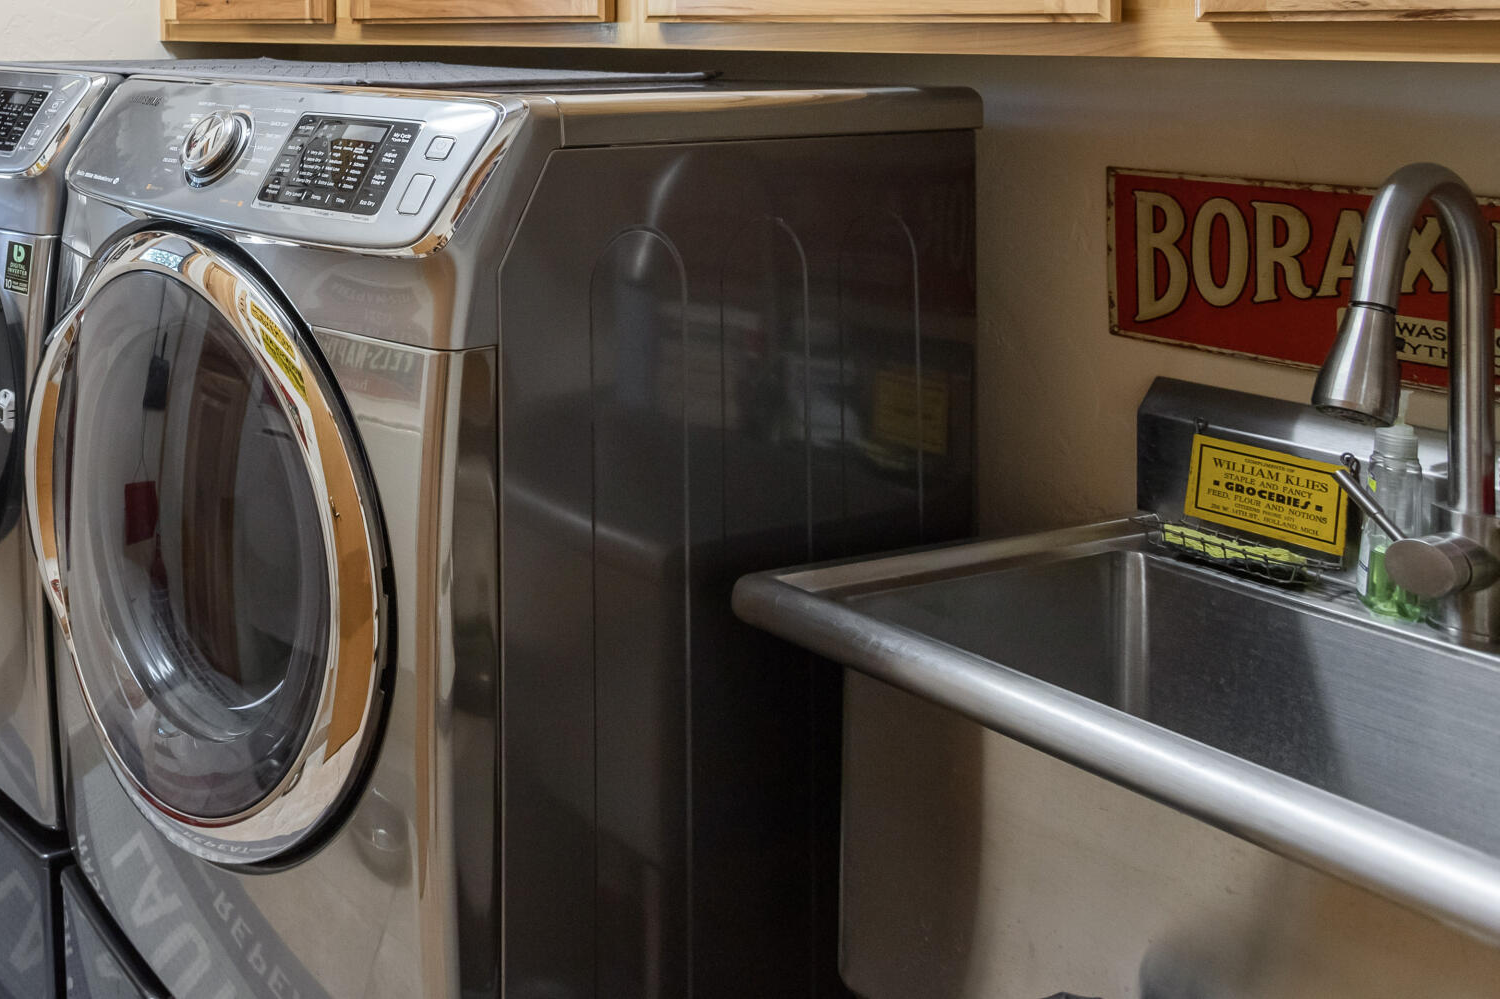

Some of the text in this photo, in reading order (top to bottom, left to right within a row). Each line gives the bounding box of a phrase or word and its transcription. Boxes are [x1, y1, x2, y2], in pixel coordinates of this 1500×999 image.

[1133, 189, 1448, 322] BORAX
[5, 279, 12, 288] 10
[1212, 457, 1329, 493] WILLIAM KLIES
[1224, 473, 1313, 499] STAPLE AND FANCY
[1225, 481, 1311, 510] GROCERIES
[1234, 494, 1261, 508] FLOUR
[1265, 503, 1285, 513] AND
[1288, 508, 1328, 525] NOTIONS
